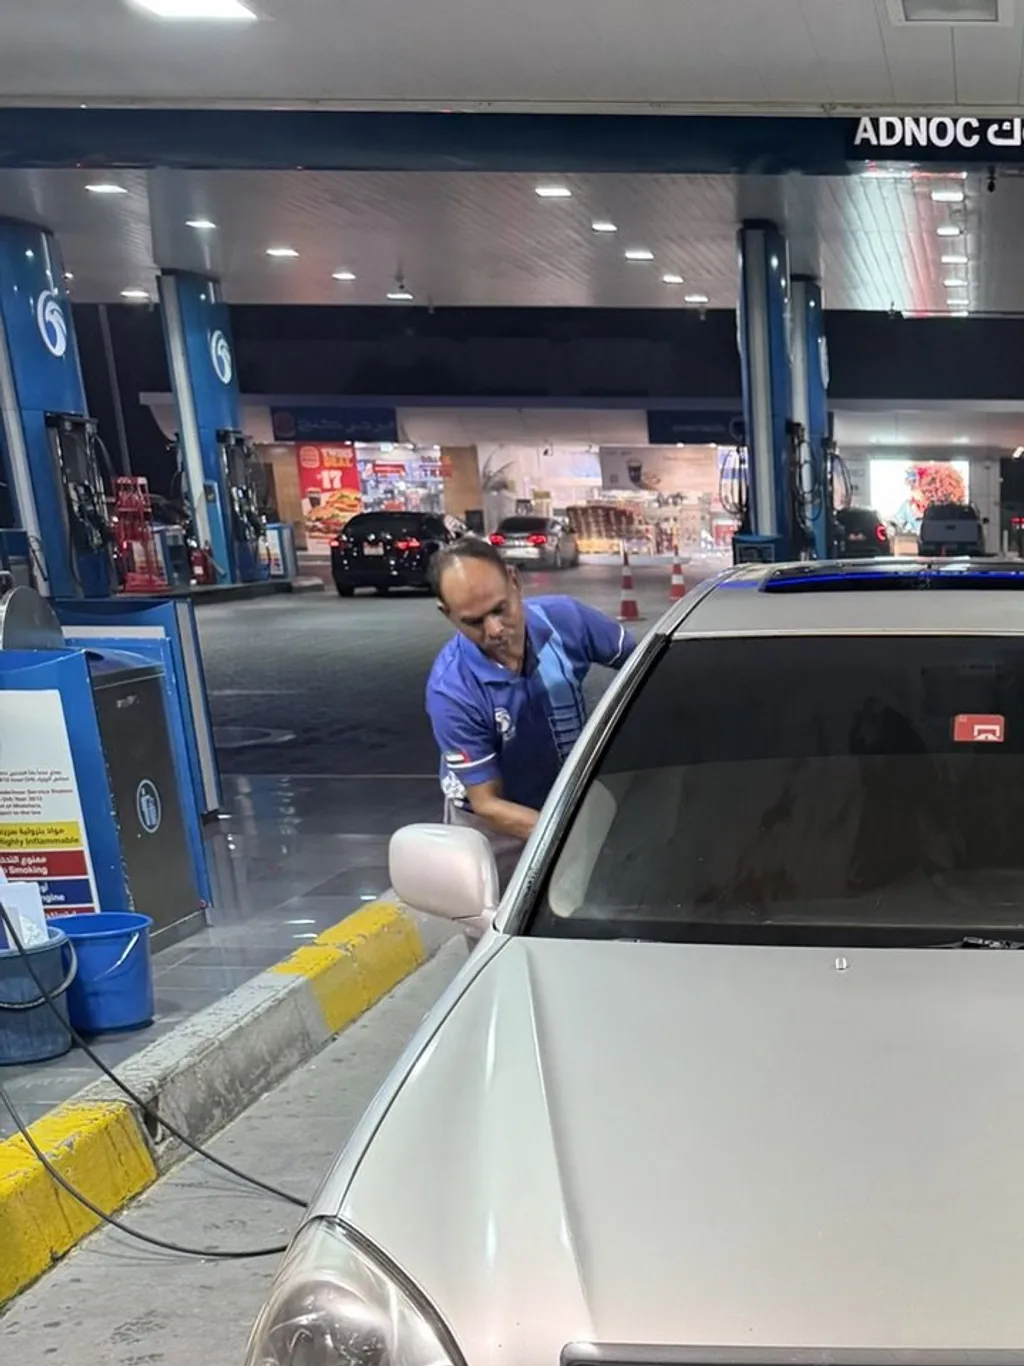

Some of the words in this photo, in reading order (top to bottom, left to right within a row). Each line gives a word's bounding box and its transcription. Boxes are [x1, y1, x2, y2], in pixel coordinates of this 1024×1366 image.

[853, 116, 980, 147] ADNOC
[320, 469, 342, 489] 17
[8, 866, 48, 875] Smoking
[41, 894, 65, 903] ngine
